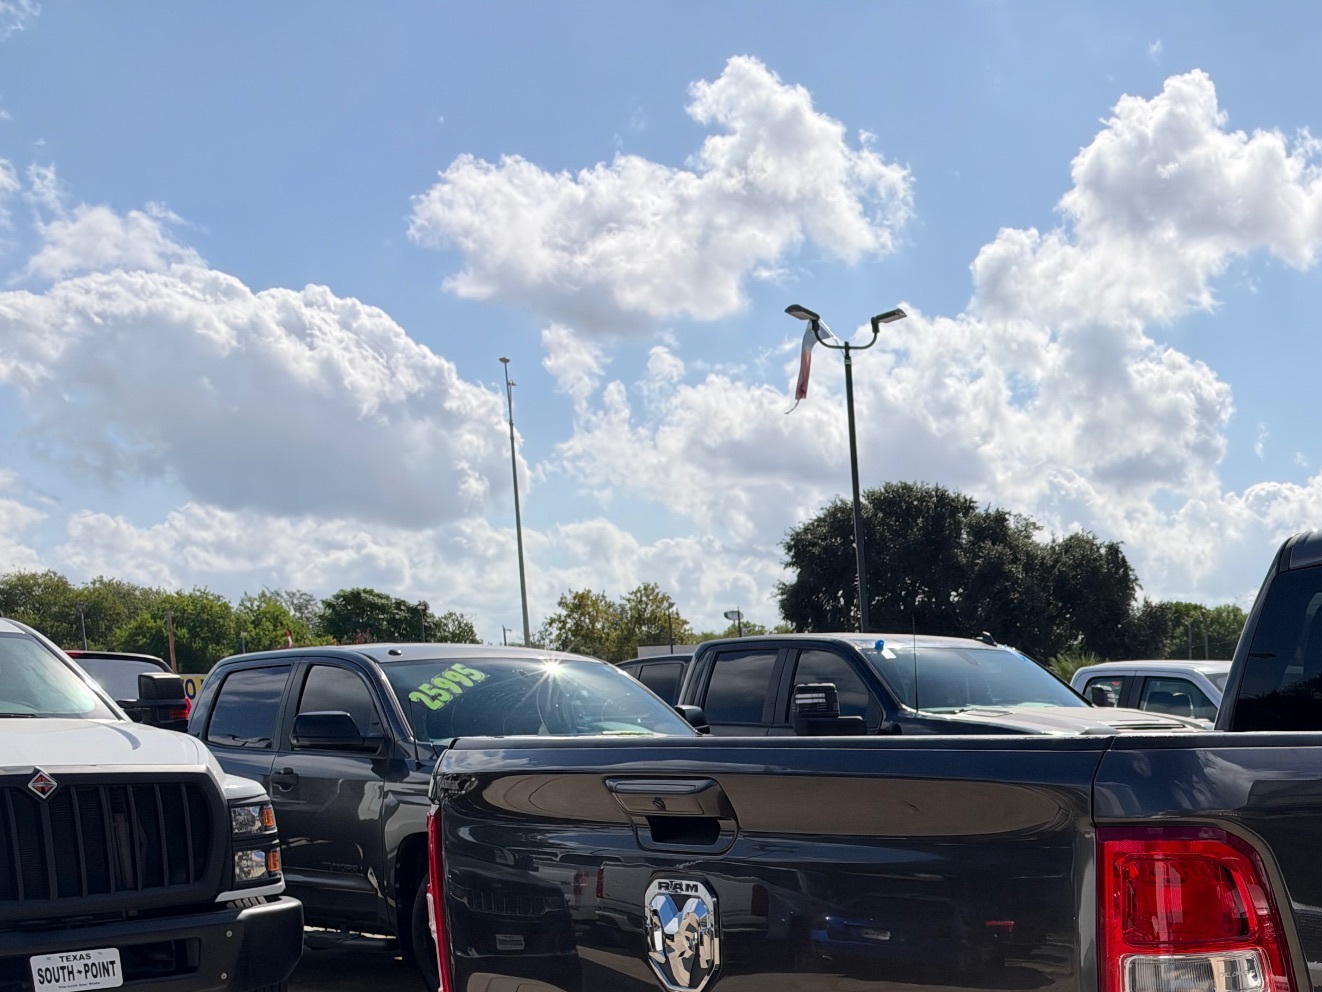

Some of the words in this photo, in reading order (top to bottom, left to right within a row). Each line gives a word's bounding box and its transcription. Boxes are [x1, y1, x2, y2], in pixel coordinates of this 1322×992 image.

[408, 663, 486, 711] 25995
[657, 881, 699, 893] RAM
[58, 953, 92, 963] TEXAS
[37, 964, 75, 985] SOUTH
[83, 960, 116, 980] POINT
